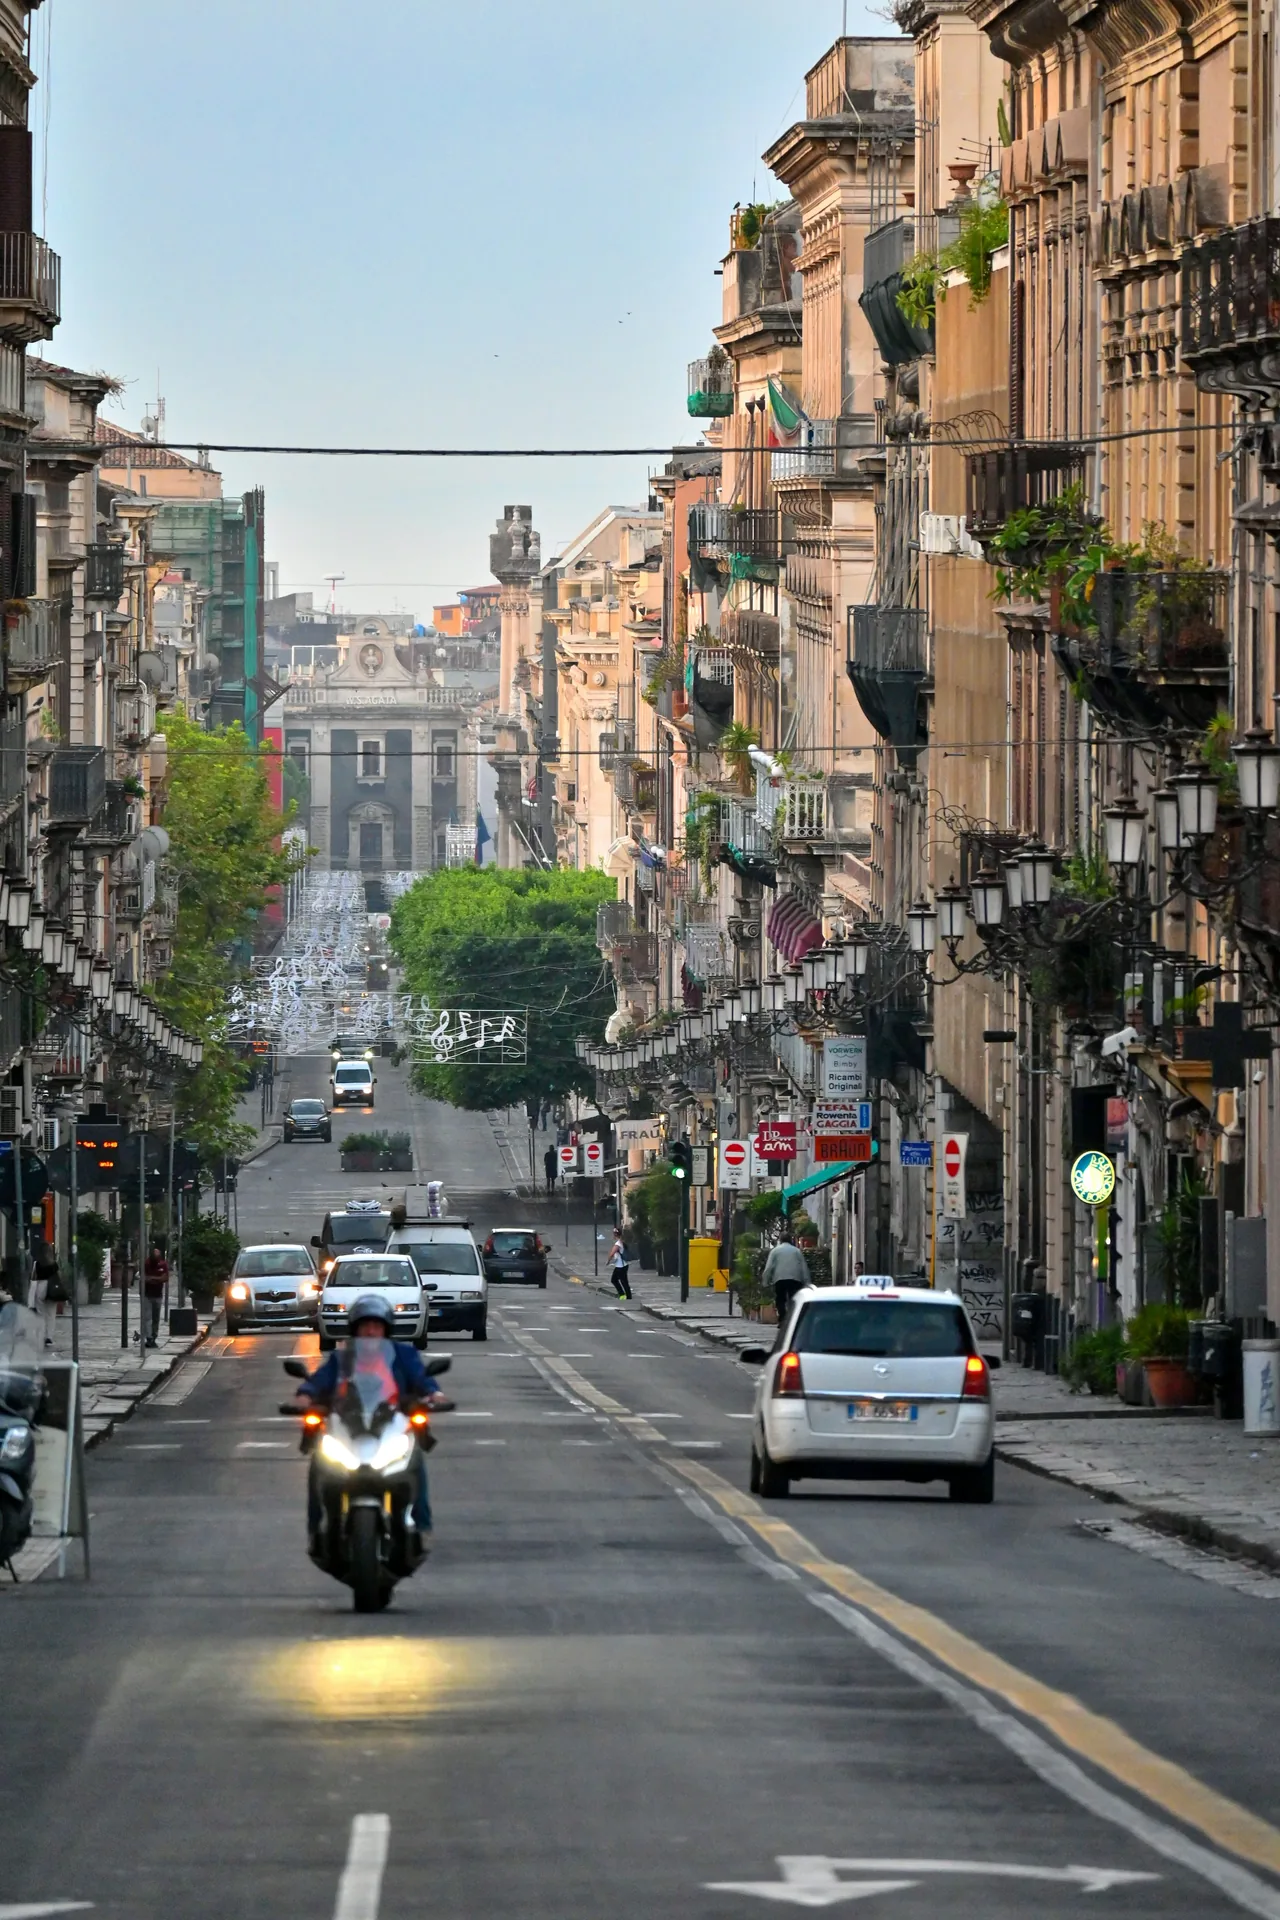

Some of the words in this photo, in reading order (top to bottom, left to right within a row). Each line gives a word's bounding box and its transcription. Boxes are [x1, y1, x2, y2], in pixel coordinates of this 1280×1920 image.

[828, 1073, 863, 1081] Ricambi
[828, 1083, 863, 1092] Originali
[816, 1104, 857, 1112] TEFAL
[816, 1112, 858, 1120] Rowenta
[816, 1120, 857, 1128] GAGGIA
[620, 1129, 660, 1140] FRAU
[820, 1139, 867, 1159] BRAUN
